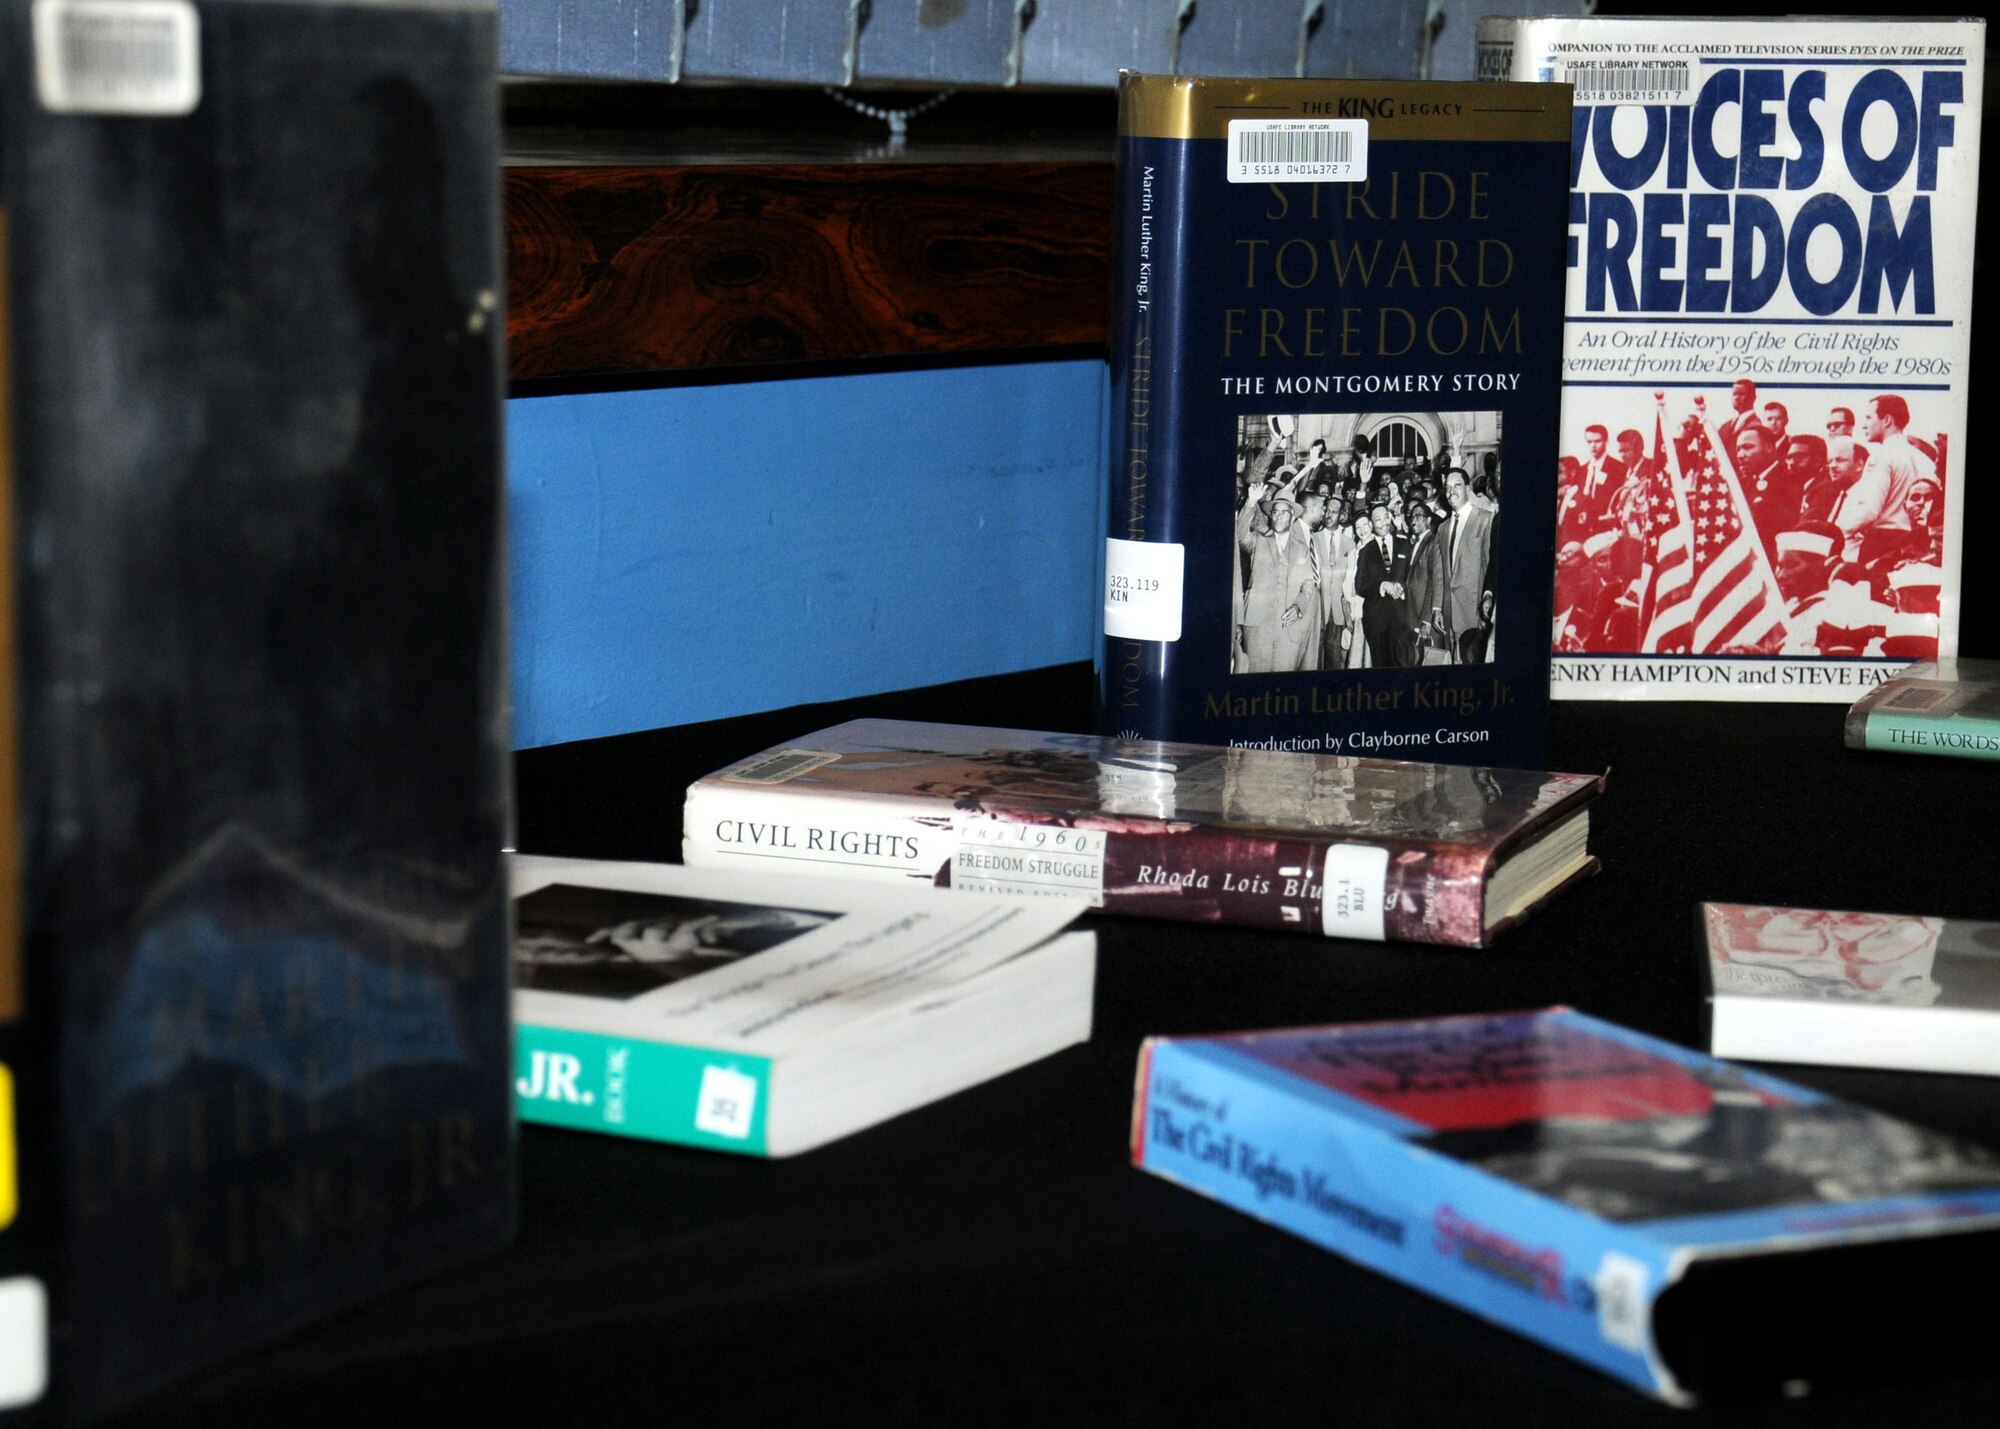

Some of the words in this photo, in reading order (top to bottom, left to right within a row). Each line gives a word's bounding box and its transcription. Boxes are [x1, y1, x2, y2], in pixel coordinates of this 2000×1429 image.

[1615, 43, 1631, 53] TO
[1634, 44, 1658, 53] THE
[1661, 44, 1732, 54] ACCLAIMED
[1734, 45, 1804, 54] TELEVISION
[1807, 45, 1847, 54] SERIES
[1849, 46, 1877, 55] EYES
[1880, 46, 1898, 55] ON
[1900, 46, 1925, 55] THE
[1927, 46, 1965, 55] PRIZE
[1567, 61, 1596, 69] USAFE
[1599, 61, 1639, 69] LIBRARY
[1642, 60, 1688, 69] NETWORK
[1302, 102, 1332, 114] THE
[1337, 97, 1395, 118] KING
[1401, 103, 1463, 115] LEGACY
[1576, 91, 1605, 100] 5518
[1610, 91, 1669, 100] 03821511
[1675, 91, 1682, 100] 7
[1842, 68, 1964, 193] OF
[1241, 166, 1247, 175] 3
[1254, 165, 1280, 175] 5518
[1287, 165, 1338, 174] 04016372
[1345, 165, 1351, 174] 7
[1142, 166, 1155, 212] Martin
[1266, 171, 1490, 220] STRIDE
[1141, 216, 1153, 260] Luther
[1235, 239, 1515, 289] TOWARD
[1136, 263, 1151, 296] King,
[1138, 299, 1150, 313] Jr.
[1223, 306, 1525, 358] FREEDOM
[1579, 331, 1607, 348] An
[1612, 330, 1657, 348] Oral
[1660, 331, 1730, 354] History
[1734, 332, 1758, 354] of
[1757, 332, 1786, 349] the
[1795, 332, 1839, 350] Civil
[1842, 333, 1900, 355] Rights
[1629, 354, 1682, 377] from
[1686, 355, 1715, 372] the
[1716, 355, 1773, 374] 1950s
[1778, 355, 1855, 379] through
[1859, 356, 1889, 374] the
[1892, 357, 1952, 376] 1980s
[1220, 377, 1265, 396] THE
[1275, 374, 1444, 395] MONTGOMERY
[1452, 373, 1521, 392] STORY
[1110, 575, 1159, 591] 323.119
[1110, 589, 1128, 603] KIN
[1612, 664, 1731, 683] HAMPTON
[1738, 666, 1776, 684] and
[1782, 667, 1852, 684] STEVE
[1204, 686, 1300, 719] Martin
[1310, 683, 1403, 713] Luther
[1413, 681, 1482, 717] King,
[1491, 679, 1516, 711] Jr.
[1230, 735, 1320, 750] Introduction
[1325, 732, 1343, 753] by
[1349, 730, 1430, 752] Clayborne
[1435, 727, 1490, 745] Carson
[1888, 728, 1927, 745] THE
[1932, 732, 2000, 751] WORDS
[716, 820, 797, 848] CIVIL
[807, 827, 919, 859] RIGHTS
[961, 827, 1006, 840] THE
[958, 853, 1023, 872] FREEDOM
[1028, 859, 1099, 879] STRUGGLE
[1136, 865, 1209, 889] Rhoda
[1223, 873, 1270, 894] Lois
[1337, 879, 1349, 918] 323.1
[1354, 887, 1364, 911] BLU
[515, 1050, 596, 1107] JR.
